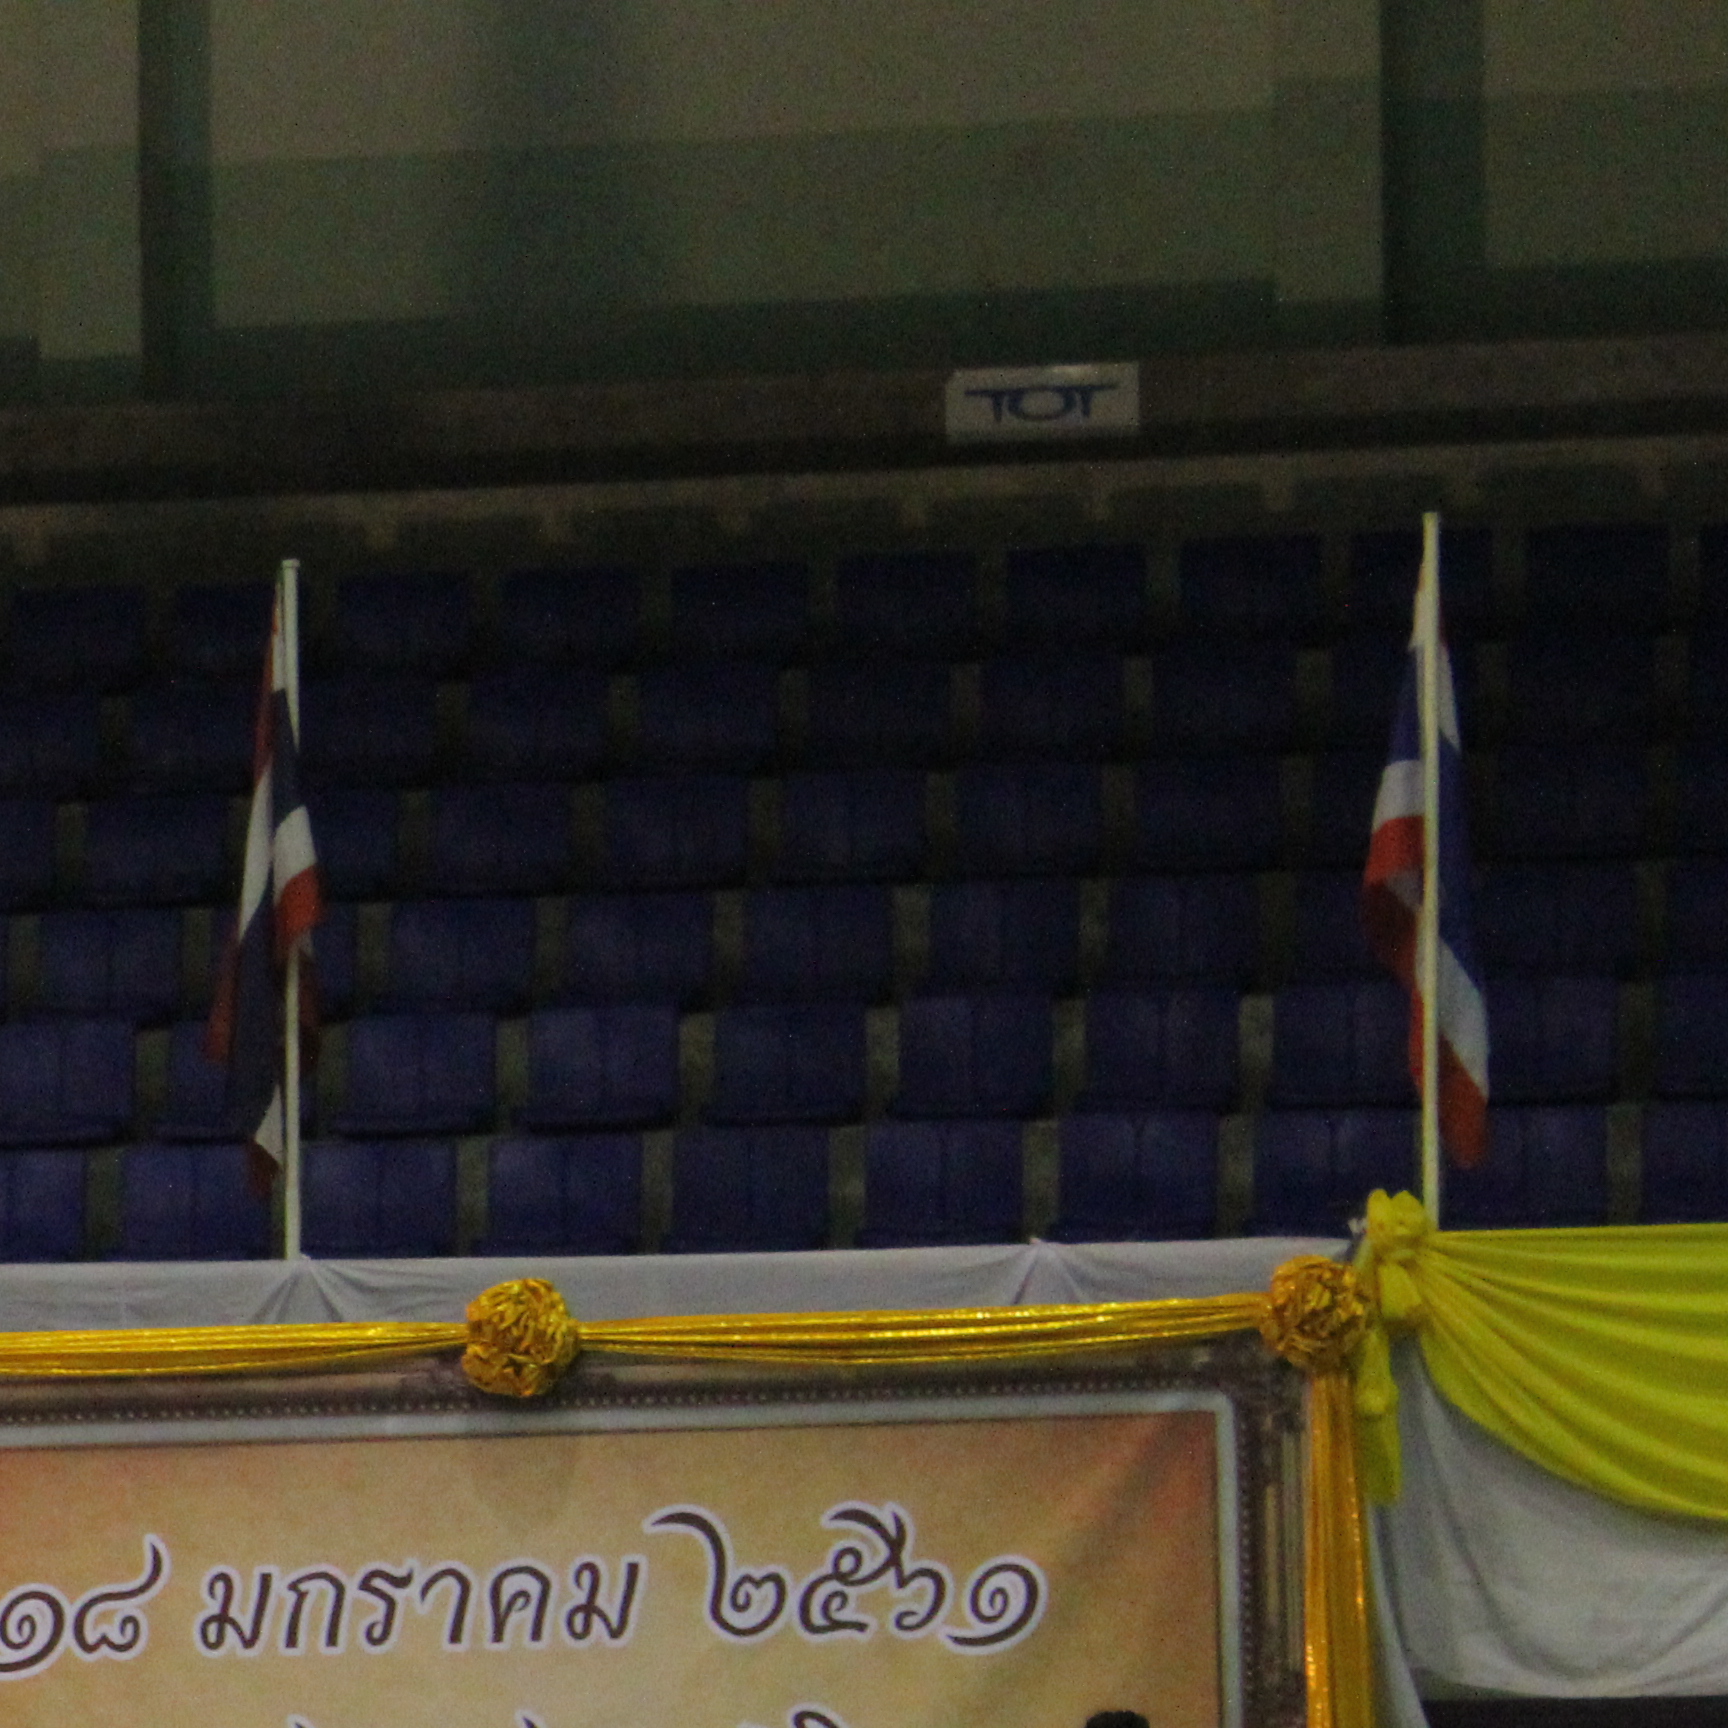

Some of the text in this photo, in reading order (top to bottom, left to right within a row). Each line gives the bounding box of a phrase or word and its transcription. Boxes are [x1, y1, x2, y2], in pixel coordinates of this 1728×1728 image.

[964, 383, 1119, 423] TOT
[198, 1553, 643, 1654] มกราคม
[648, 1503, 1044, 1649] ๒๕๖๑
